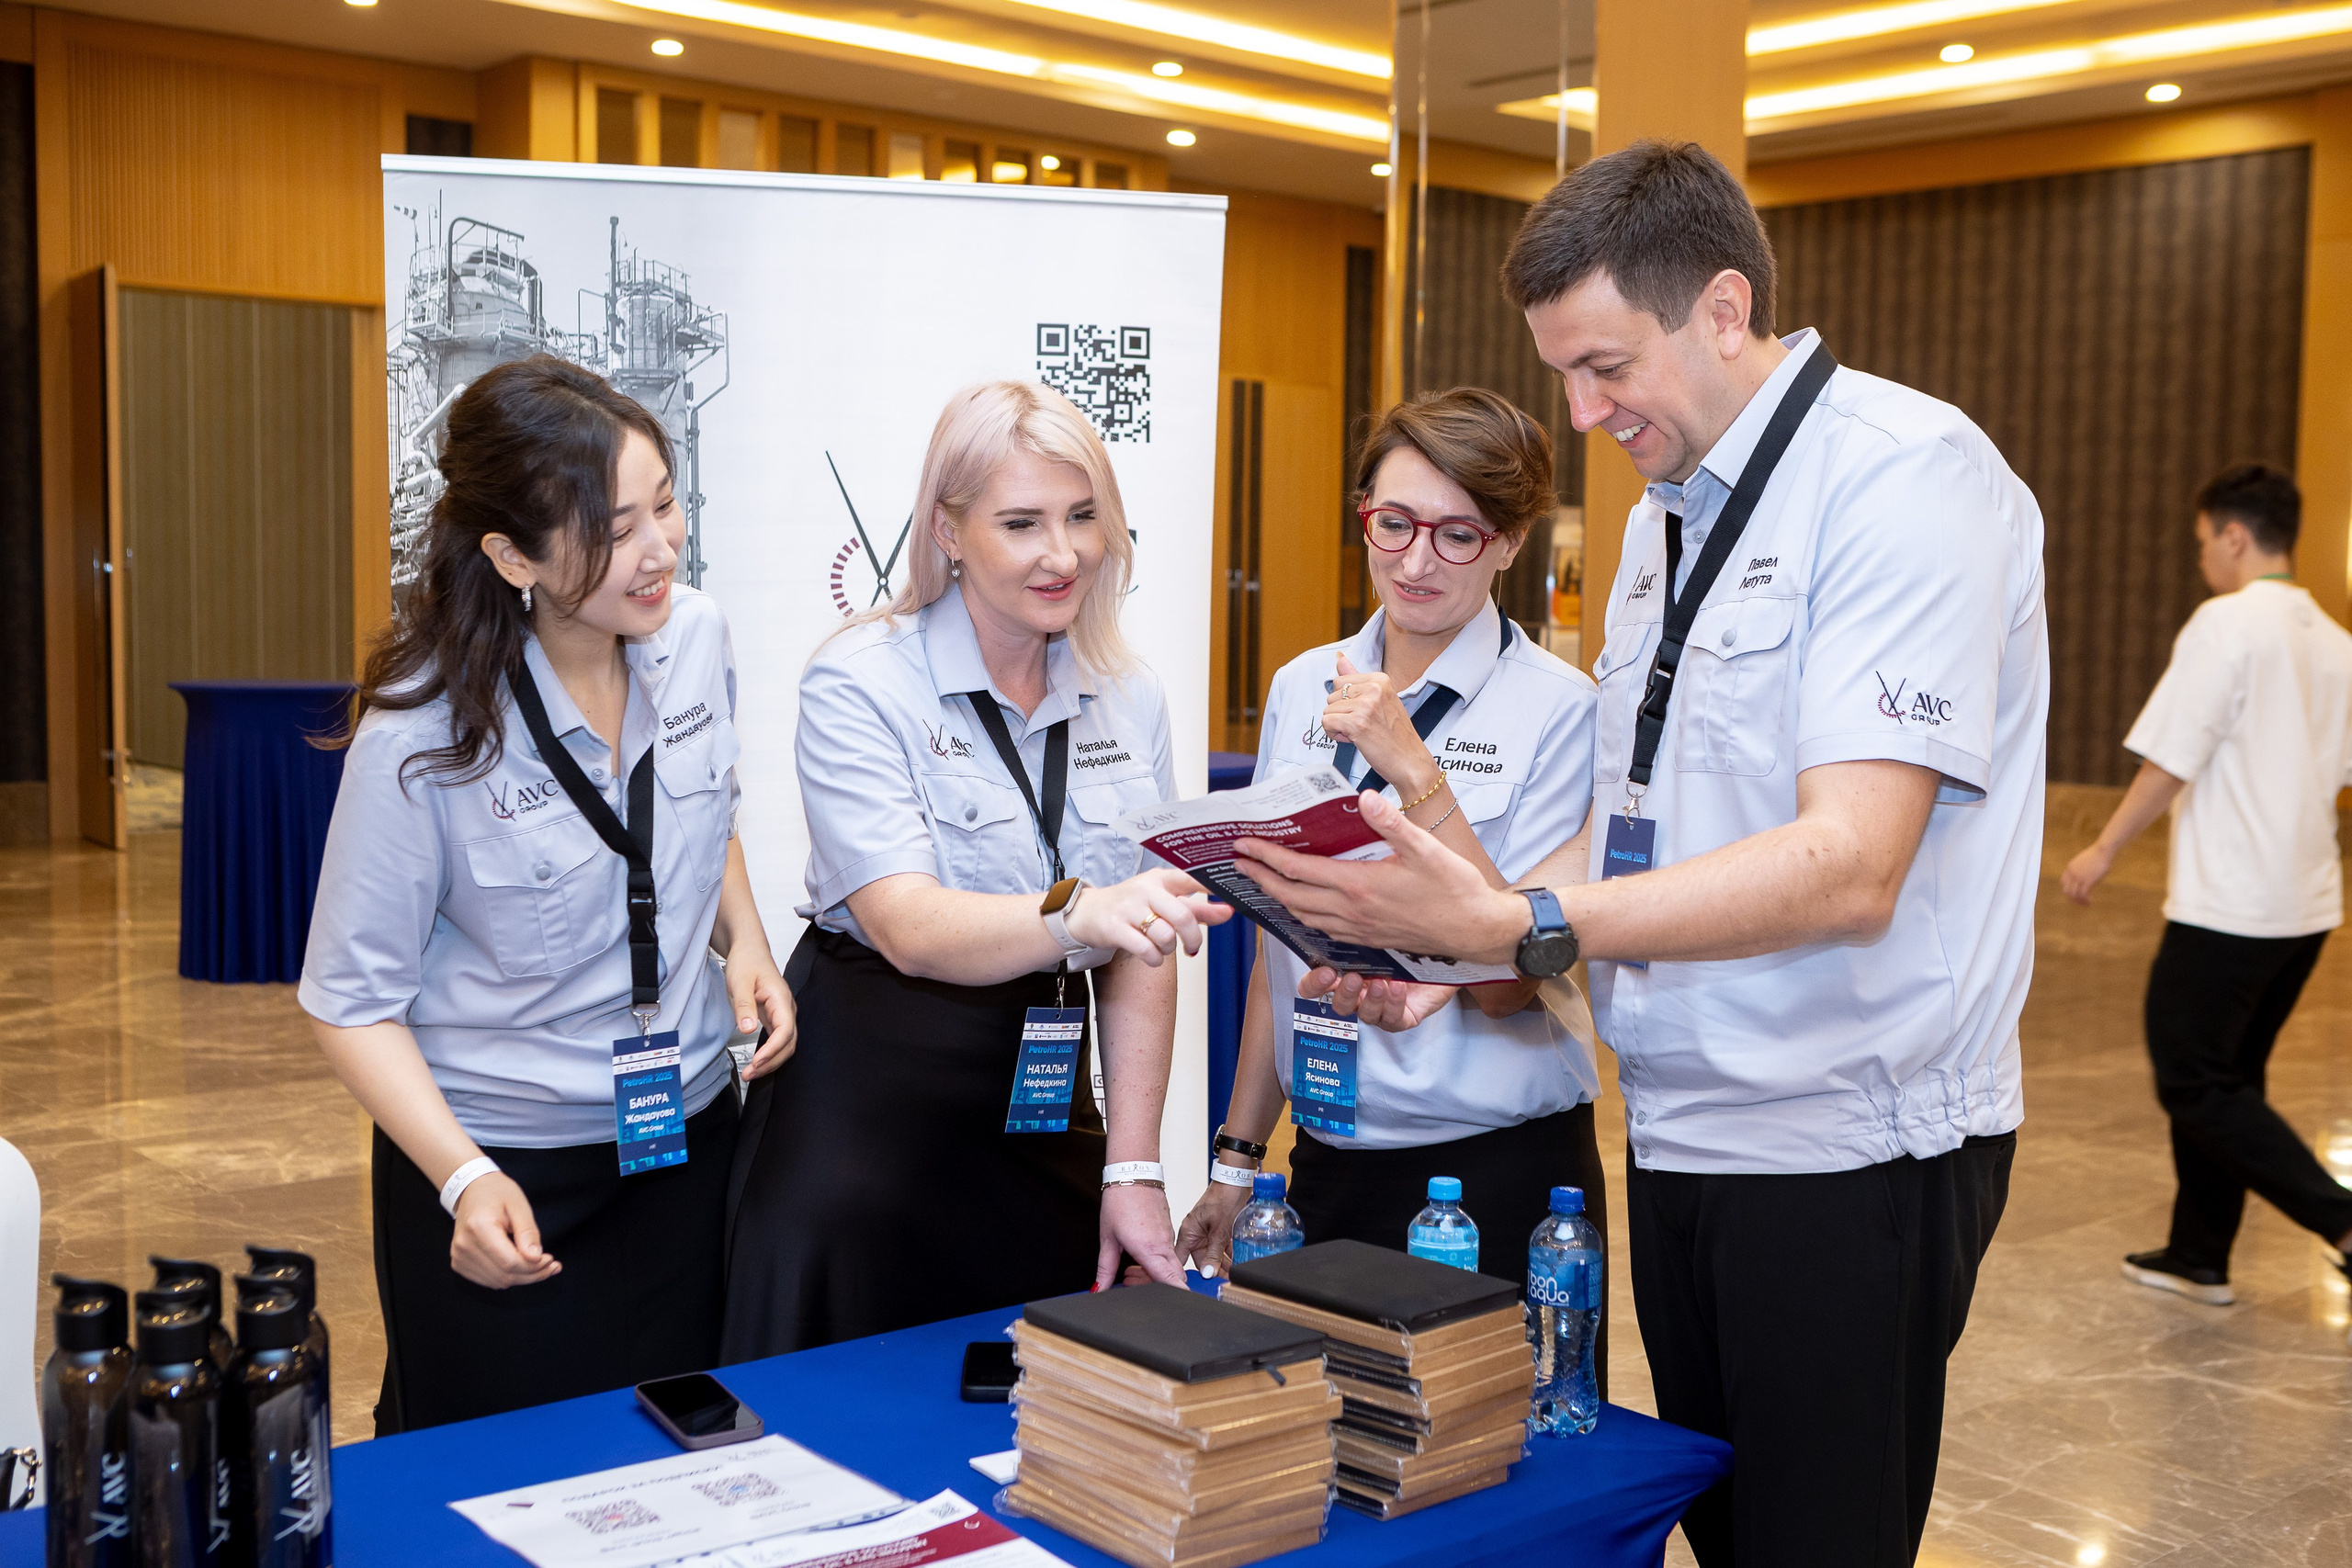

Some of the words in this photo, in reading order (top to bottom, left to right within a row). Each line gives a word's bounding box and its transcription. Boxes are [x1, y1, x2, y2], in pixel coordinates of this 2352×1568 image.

[1747, 557, 1778, 572] Павел
[1738, 574, 1772, 591] Летута
[1912, 692, 1952, 721] AVC
[662, 702, 707, 730] Банура
[950, 737, 975, 758] AVC
[1076, 739, 1118, 754] Наталья
[1444, 738, 1498, 755] Елена
[1073, 751, 1132, 770] Нефедкина
[517, 779, 559, 807] AVC
[519, 800, 548, 814] GROUP
[1156, 822, 1238, 843] COMPREHENSIVE
[1238, 818, 1294, 831] SOLUTIONS
[1163, 839, 1184, 849] FOR
[1254, 826, 1303, 837] INDUSTRY
[1610, 848, 1633, 862] PetroHR
[1633, 852, 1647, 863] 2025
[1028, 1044, 1057, 1054] PetroHR
[1057, 1044, 1073, 1054] 2025
[1300, 1036, 1328, 1050] PetroHR
[1329, 1042, 1349, 1054] 2025
[1026, 1064, 1069, 1075] НАТАЛЬЯ
[1306, 1057, 1339, 1073] ЕЛЕНА
[622, 1073, 653, 1089] PetroHR
[655, 1071, 673, 1083] 2025
[1023, 1078, 1067, 1089] Нефедкина
[1306, 1072, 1340, 1087] Ясинова
[629, 1092, 669, 1110] БАНУРА
[1309, 1087, 1319, 1095] AVC
[1319, 1089, 1334, 1098] Group
[625, 1107, 675, 1124] Жандауова
[1531, 1269, 1557, 1290] bon
[1530, 1286, 1569, 1303] aqua
[101, 1450, 127, 1505] AVC
